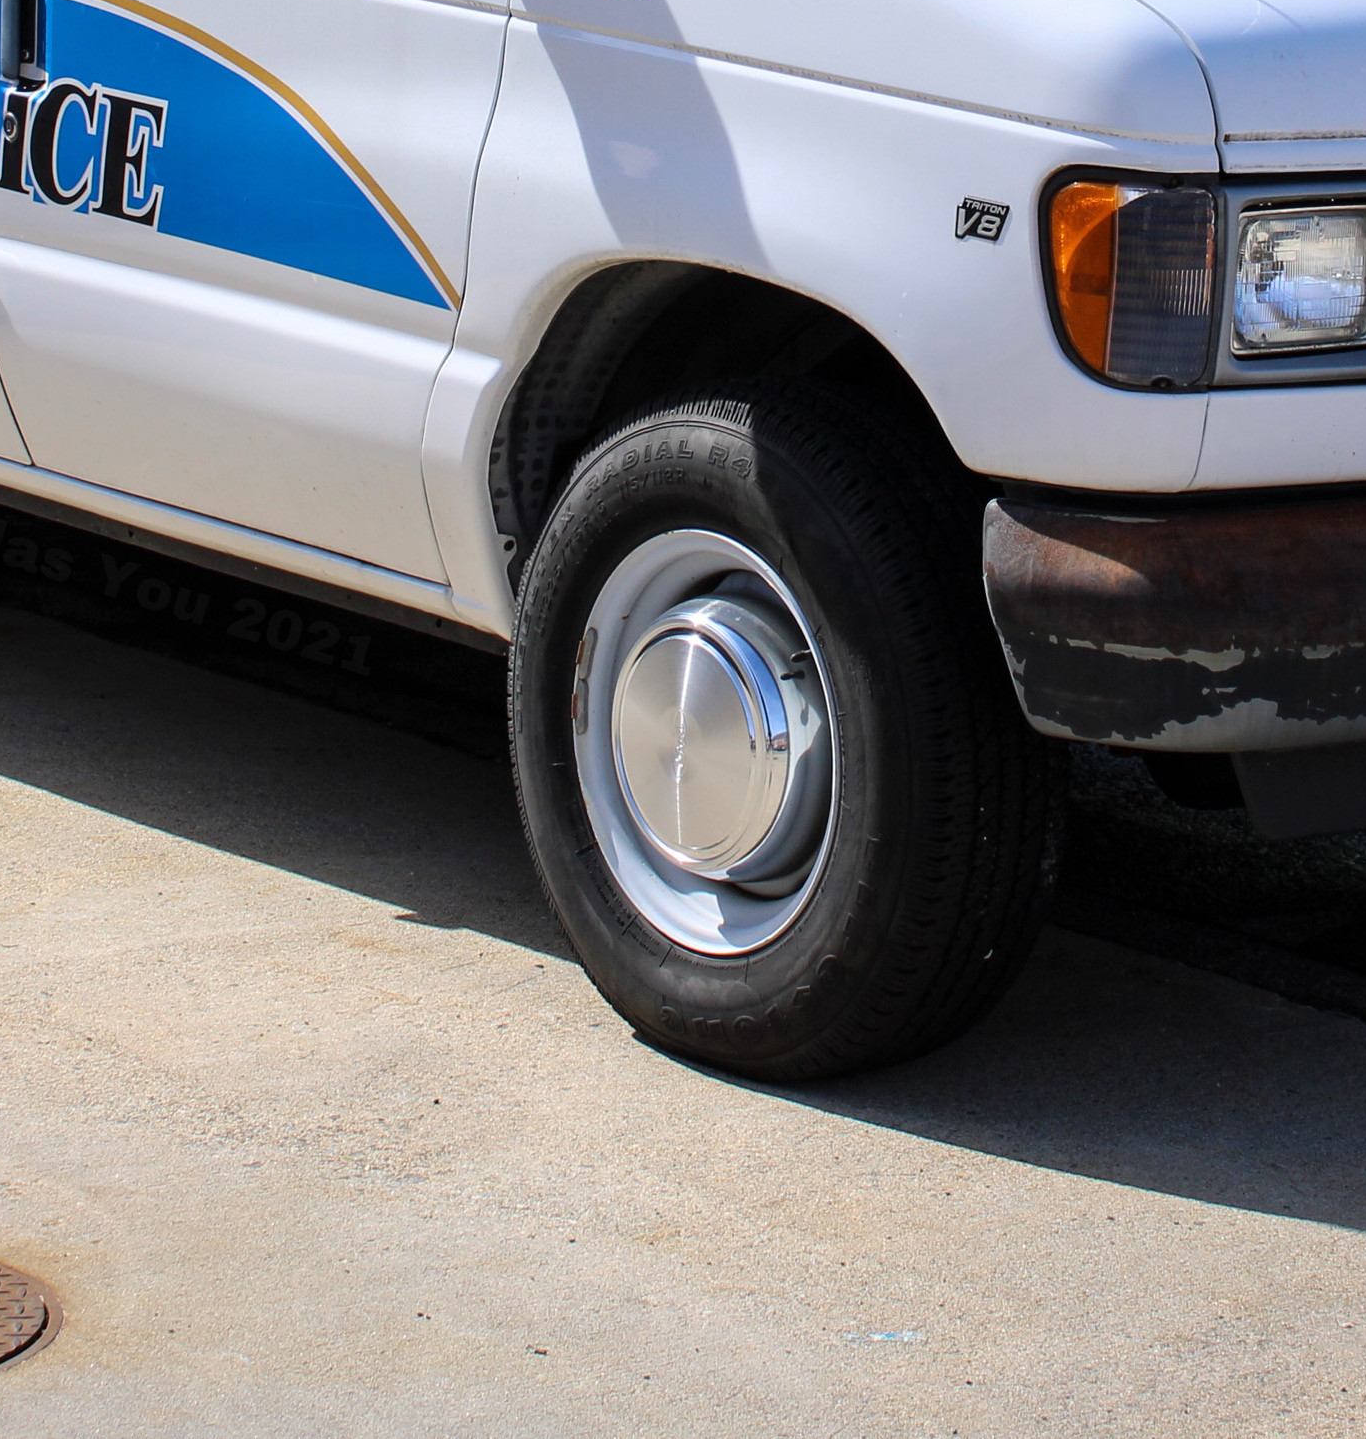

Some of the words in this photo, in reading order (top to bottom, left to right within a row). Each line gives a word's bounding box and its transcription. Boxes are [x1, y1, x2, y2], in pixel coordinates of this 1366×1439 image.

[956, 207, 1001, 238] V8
[965, 199, 1007, 216] TRITON
[584, 438, 694, 501] RADIAL
